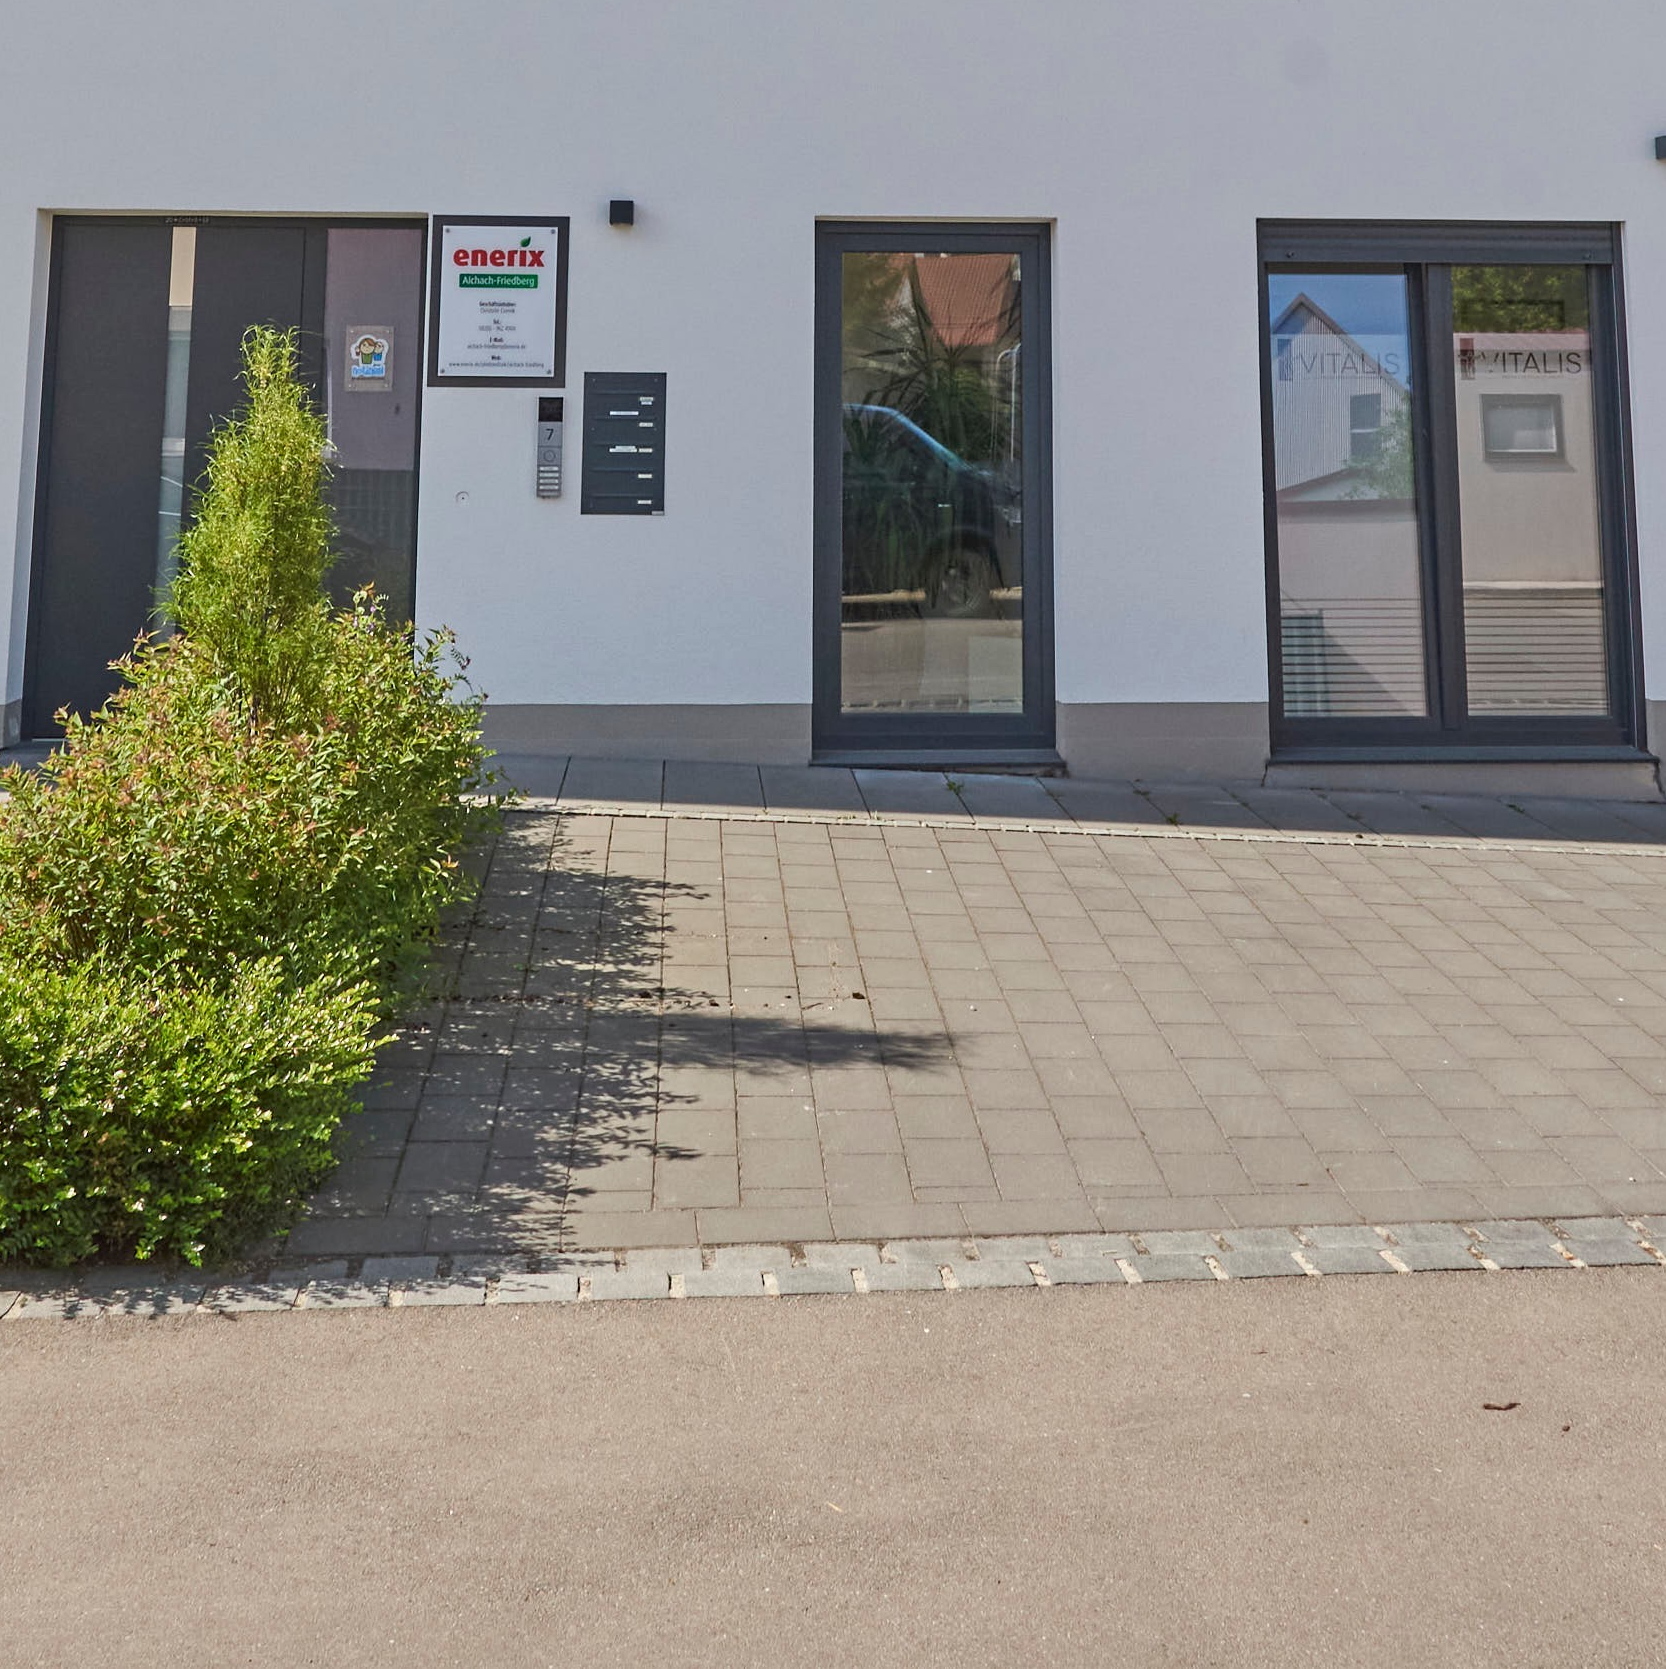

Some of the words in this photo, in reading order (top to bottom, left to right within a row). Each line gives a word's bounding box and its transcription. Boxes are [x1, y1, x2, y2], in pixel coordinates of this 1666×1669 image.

[453, 236, 545, 267] enerix
[462, 276, 535, 287] Aichach-Friedberg
[1299, 352, 1400, 375] VITALIS
[545, 428, 554, 441] 7
